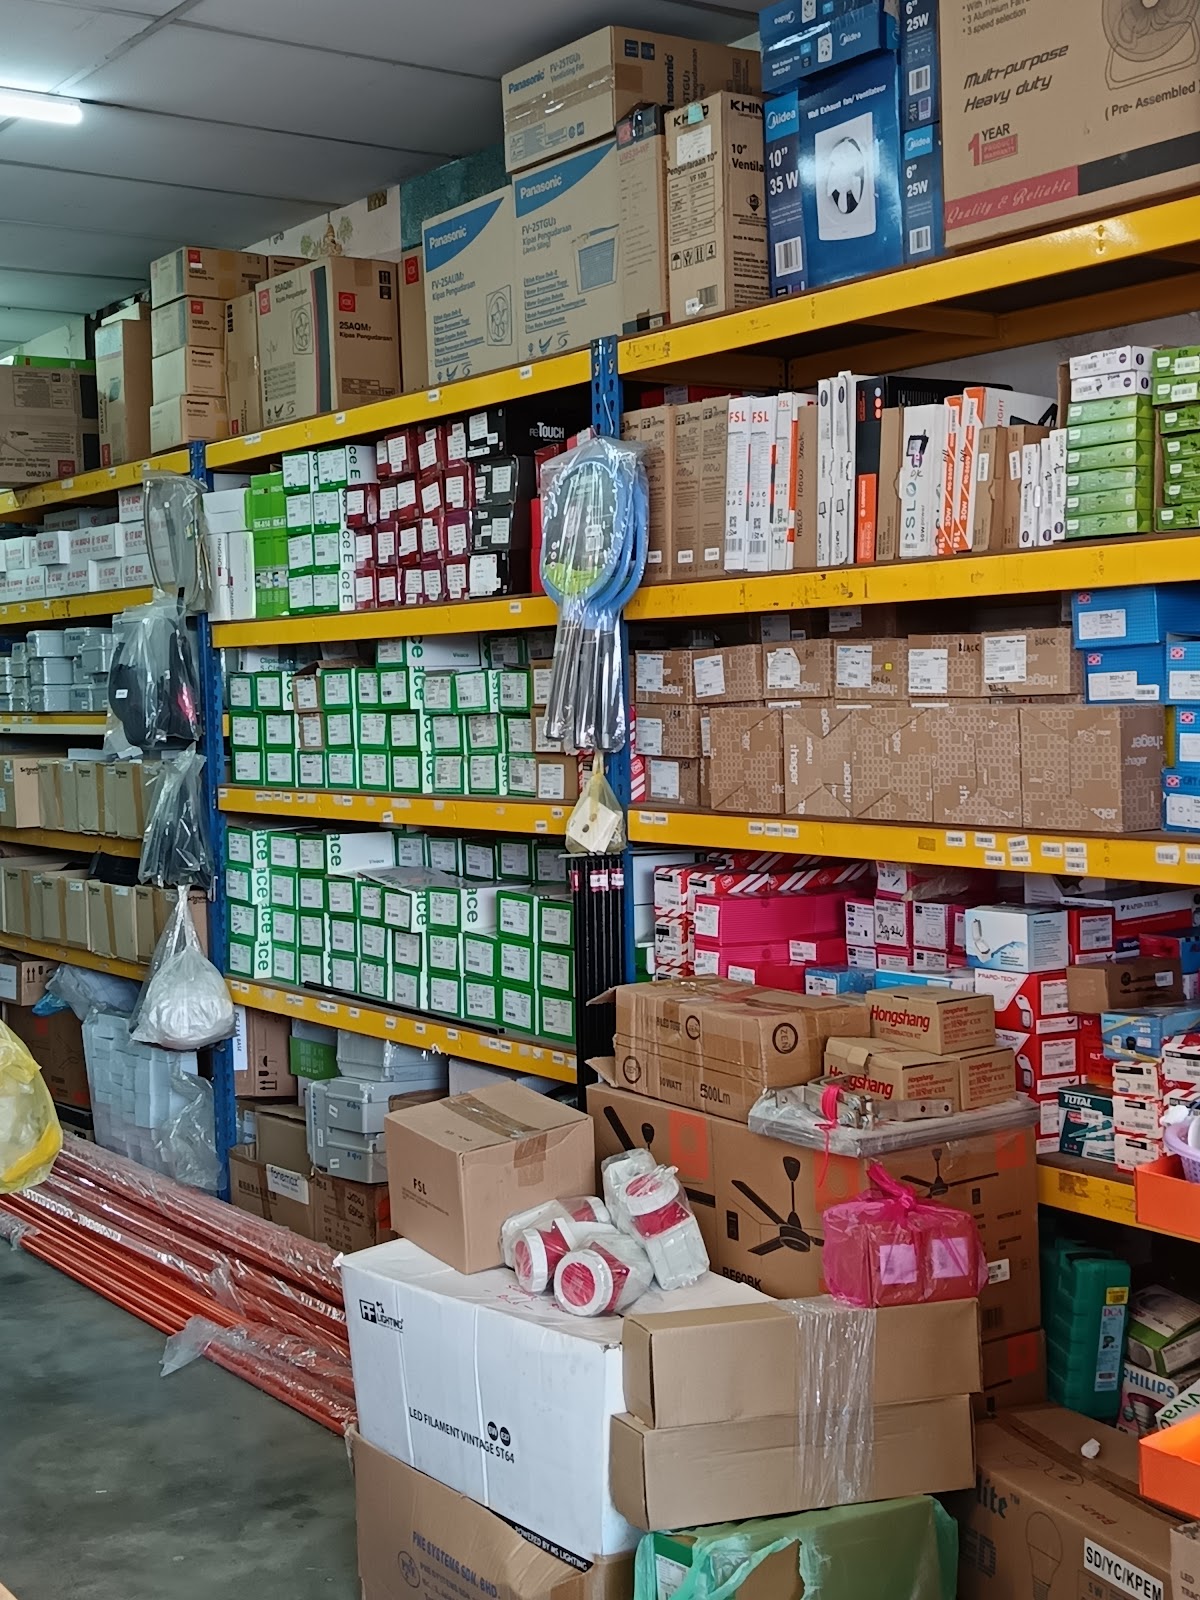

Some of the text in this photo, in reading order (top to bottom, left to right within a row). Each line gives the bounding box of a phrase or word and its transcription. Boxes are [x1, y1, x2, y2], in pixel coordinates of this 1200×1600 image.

[906, 13, 929, 31] 25W
[973, 19, 994, 34] speed
[995, 8, 1027, 26] selection
[508, 68, 545, 94] Panasonic
[963, 75, 1053, 112] Heavy duty
[1135, 83, 1196, 109] Assembled
[820, 99, 842, 115] Exhaust
[767, 109, 796, 129] Midea
[982, 123, 1011, 142] YEAR
[968, 133, 981, 167] 1
[520, 174, 563, 200] Panasonic
[769, 170, 798, 196] 35 W
[906, 180, 929, 198] 25W
[946, 202, 992, 224] Quality
[429, 225, 468, 250] Panasonic
[339, 331, 393, 342] Kipas Pengudaraan
[729, 411, 746, 423] FSL
[751, 411, 769, 423] FSL
[938, 507, 952, 554] FSL 30W
[953, 530, 961, 548] FSL
[960, 501, 968, 521] 30W
[870, 1005, 931, 1032] Hongshang
[1063, 1093, 1092, 1107] TOTAL
[412, 1177, 427, 1196] FSL
[377, 1312, 403, 1331] LIGHTING
[1103, 1307, 1123, 1317] DCA
[408, 1406, 515, 1464] LED FILAMENT VINTAGE ST64
[426, 1541, 460, 1574] SYSTEMS
[461, 1567, 479, 1587] SDN.
[559, 1550, 588, 1571] LIGHTING
[1180, 1570, 1195, 1585] LED
